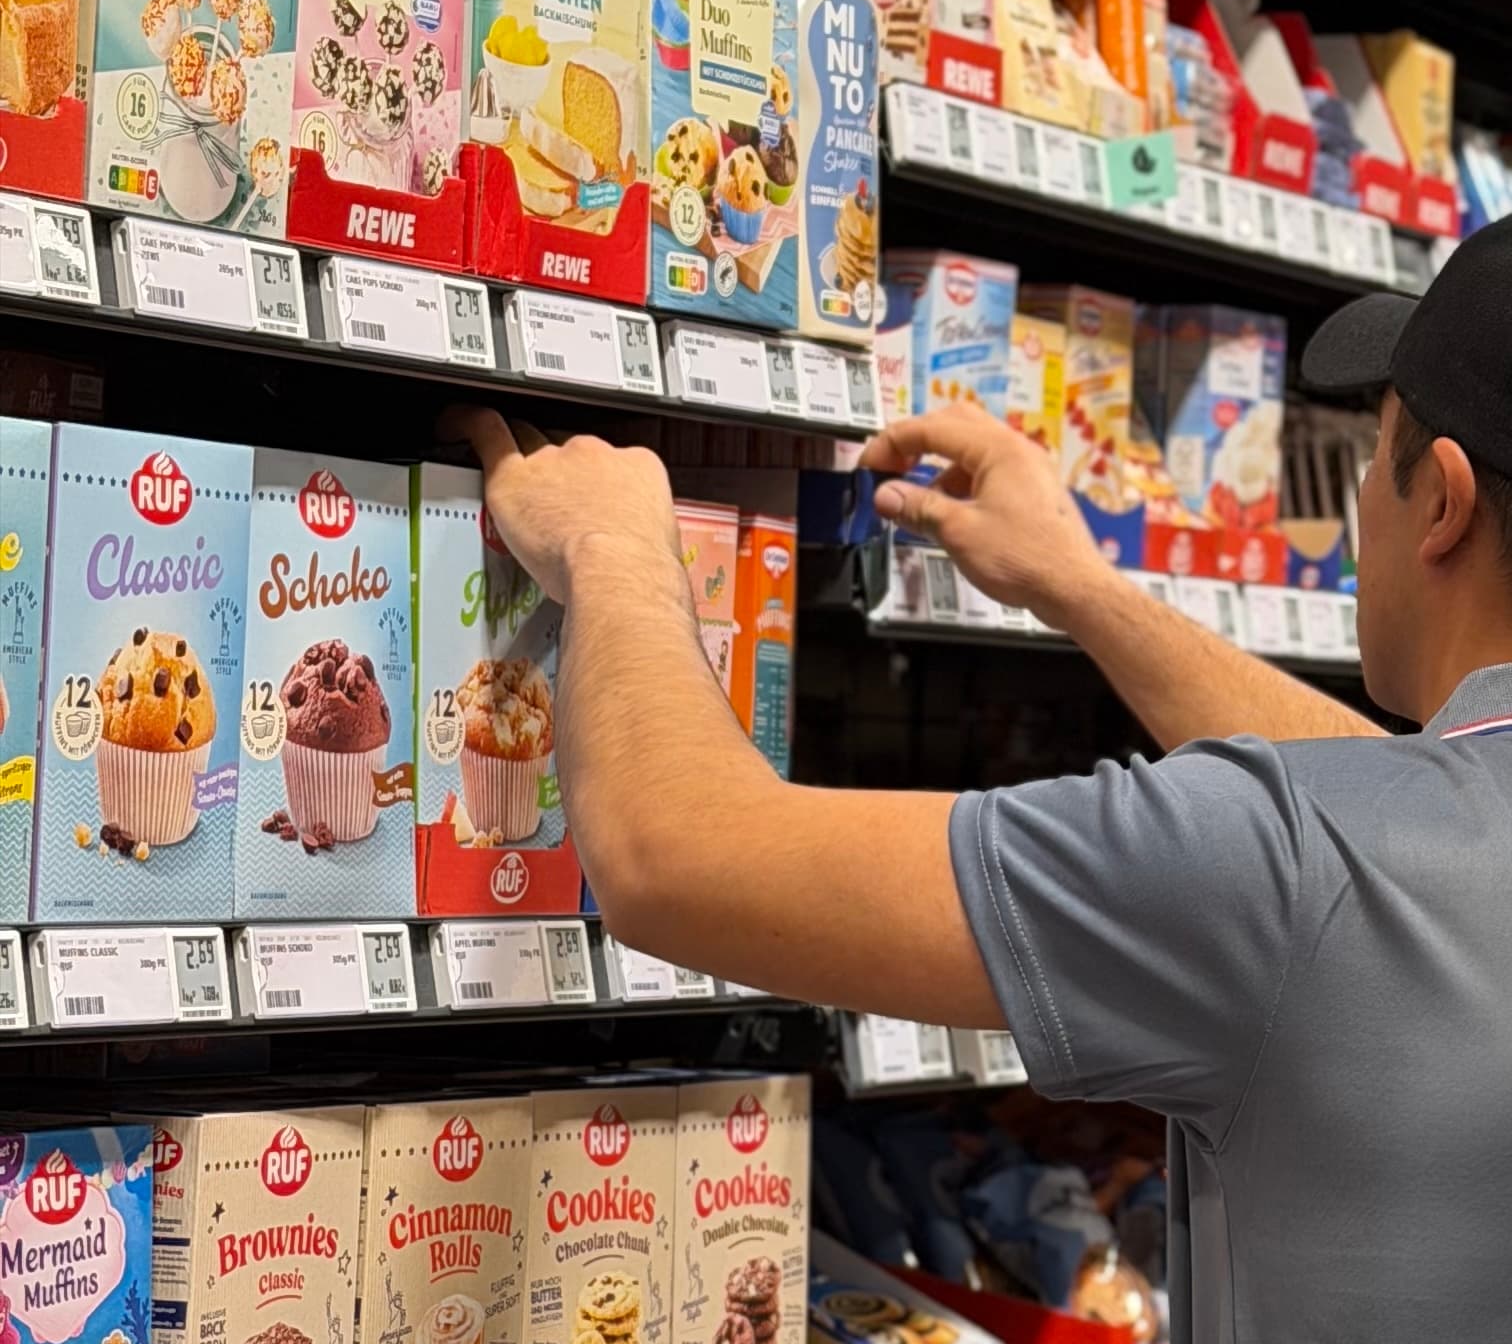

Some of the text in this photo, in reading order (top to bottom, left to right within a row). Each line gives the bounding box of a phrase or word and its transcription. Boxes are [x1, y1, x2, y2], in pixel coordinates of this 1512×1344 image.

[533, 5, 598, 34] BACKMISCHUNG
[824, 1, 856, 38] MI
[699, 27, 753, 64] Muffins
[827, 37, 863, 78] NU
[829, 75, 864, 115] TO
[942, 57, 996, 102] REWE
[129, 93, 146, 117] 16
[310, 128, 327, 153] 16
[826, 125, 874, 157] PANCAKE
[346, 203, 417, 248] REWE
[681, 203, 695, 225] 12
[263, 256, 292, 286] 2.79
[541, 251, 592, 285] REWE
[454, 290, 481, 318] 2.79
[624, 322, 649, 348] 2.49
[138, 475, 188, 514] RUF
[305, 492, 351, 528] RUF
[86, 533, 225, 601] Classic
[259, 544, 393, 620] Schoko
[1, 581, 39, 610] MUFFINS
[208, 597, 243, 625] MUFFINS
[65, 676, 92, 710] 12
[249, 681, 276, 711] 12
[433, 689, 456, 718] 12
[496, 869, 524, 893] RUF
[187, 939, 215, 969] 2.69
[374, 935, 401, 963] 2.69
[589, 1123, 627, 1156] RUF
[732, 1114, 767, 1145] RUF
[266, 1148, 309, 1185] RUF
[439, 1137, 480, 1172] RUF
[32, 1174, 82, 1214] RUF
[547, 1175, 657, 1234] Cookies
[695, 1161, 792, 1219] Cookies
[388, 1203, 514, 1250] Cinnamon
[702, 1216, 741, 1248] Double
[0, 1217, 108, 1280] Mermaid
[217, 1212, 339, 1278] Brownies
[429, 1234, 483, 1275] Rolls
[555, 1230, 651, 1264] Chocolate Chunk
[24, 1266, 99, 1313] Muffins
[530, 1286, 563, 1305] BUTTER
[199, 1321, 226, 1339] BACK
